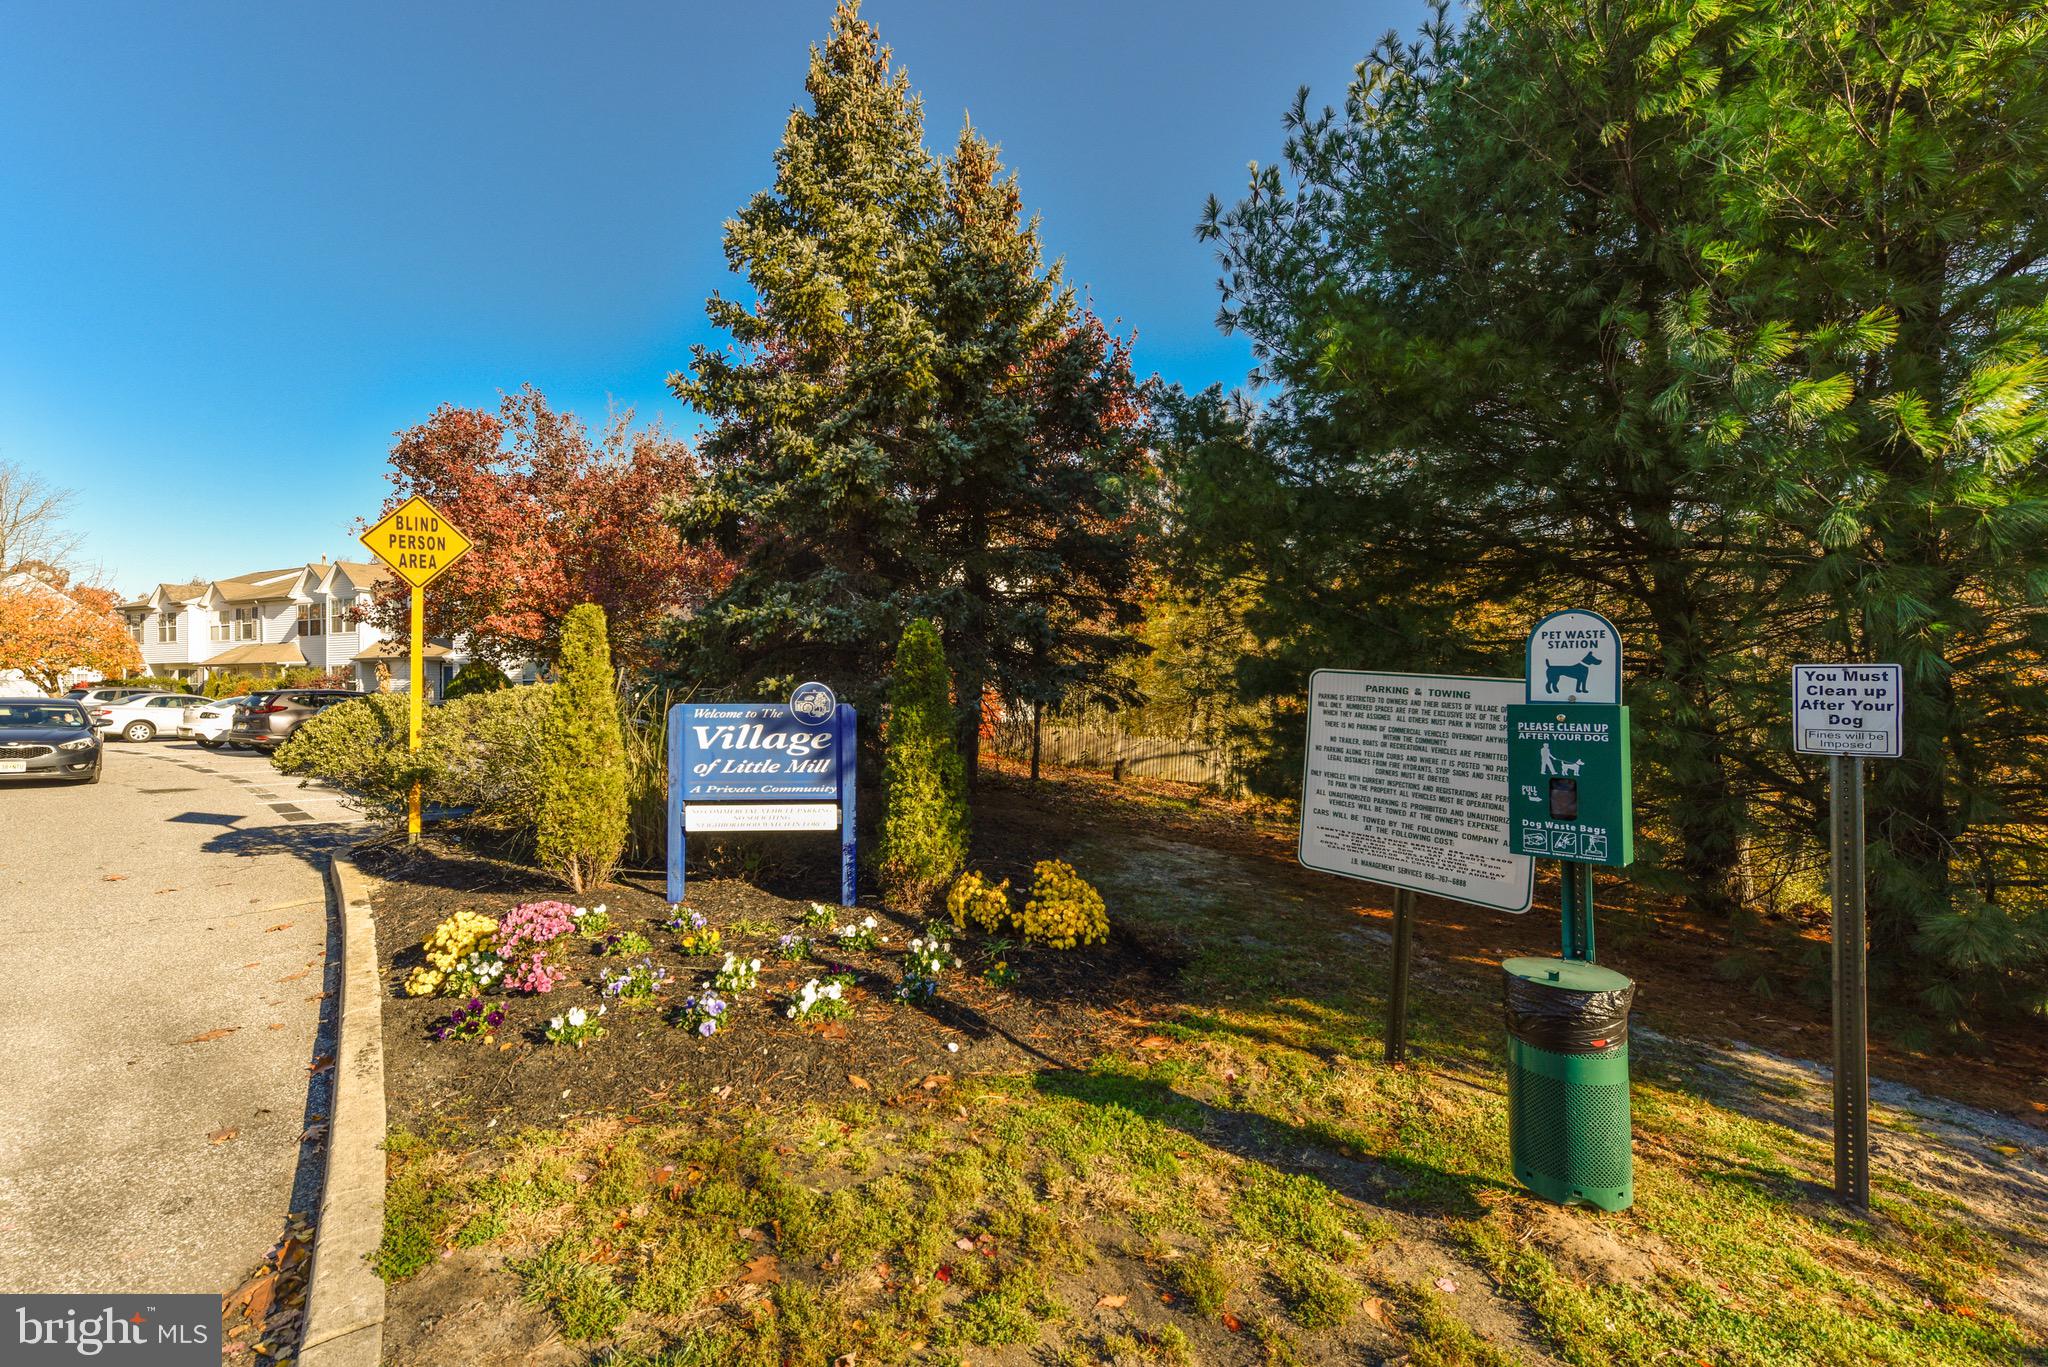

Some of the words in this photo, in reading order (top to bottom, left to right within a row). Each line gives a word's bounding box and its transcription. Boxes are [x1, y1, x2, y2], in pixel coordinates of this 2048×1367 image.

[396, 516, 439, 532] BLIND
[389, 534, 446, 551] PERSON
[399, 553, 437, 569] AREA
[1542, 631, 1562, 639] PET
[1566, 630, 1605, 639] WASTE
[1548, 640, 1598, 649] STATION
[1805, 671, 1836, 682] You
[1844, 671, 1888, 682] Must
[1365, 684, 1409, 694] PARKING
[1427, 688, 1470, 698] TOWING
[1807, 686, 1857, 696] Clean
[1864, 688, 1886, 699] up
[1346, 694, 1375, 703] RESTRICTED
[1386, 697, 1407, 705] OWNERS
[1474, 703, 1498, 712] VILLAGE
[1800, 700, 1845, 710] After
[1851, 700, 1894, 711] Your
[694, 708, 743, 718] Welcome
[746, 710, 757, 718] to
[762, 708, 783, 718] The
[1433, 709, 1462, 718] EXCLUSIVE
[1473, 722, 1496, 730] VISITOR
[1518, 722, 1554, 731] PLEASE
[1557, 723, 1590, 732] CLEAN
[1594, 724, 1608, 732] UP
[1829, 715, 1863, 728] Dog
[693, 724, 832, 755] Village
[1388, 726, 1420, 735] COMMERCIAL
[1423, 729, 1449, 738] VEHICLES
[1451, 732, 1482, 741] OVERNIGHT
[1485, 735, 1507, 744] ANYWH
[1808, 731, 1841, 739] Fines
[1389, 742, 1428, 752] RECREATIONAL
[1430, 746, 1457, 755] VEHICLES
[1820, 740, 1872, 749] Imposed
[1323, 745, 1343, 753] PARKING
[1363, 750, 1384, 758] YELLOW
[1386, 752, 1403, 760] CURBS
[1419, 756, 1438, 765] WHERE
[1456, 760, 1480, 770] POSTED
[693, 759, 719, 776] of
[720, 759, 781, 774] Little
[784, 759, 831, 773] Mill
[1344, 756, 1370, 765] DISTANCES
[1452, 769, 1469, 777] SIGNS
[1374, 768, 1398, 777] CORNERS
[1400, 771, 1415, 779] MUST
[706, 785, 756, 793] Private
[760, 785, 837, 794] Community
[1323, 771, 1345, 779] VEHICLES
[1362, 776, 1384, 785] CURRENT
[1386, 779, 1420, 790] INSPECTIONS
[1435, 786, 1478, 798] REGISTRATIONS
[1411, 791, 1436, 801] VEHICLES
[1438, 795, 1453, 803] MUST
[1328, 790, 1371, 802] UNAUTHORIZED
[1373, 797, 1398, 807] PARKING
[1410, 802, 1447, 814] PROHIBITED
[1450, 808, 1463, 817] AND
[1466, 811, 1509, 824] UNAUTHORIZ
[1328, 798, 1354, 808] VEHICLES
[1357, 802, 1371, 811] WILL
[1385, 807, 1406, 816] TOWED
[1420, 812, 1431, 820] THE
[1434, 814, 1464, 826] OWNER'S
[1312, 807, 1329, 816] CARS
[1332, 811, 1347, 819] WILL
[1362, 816, 1385, 826] TOWED
[1400, 822, 1414, 830] THE
[1417, 825, 1458, 838] FOLLOWING
[1461, 832, 1498, 845] COMPANY
[1522, 819, 1542, 829] Dog
[1545, 821, 1576, 831] Waste
[1580, 825, 1606, 834] Bags
[1375, 826, 1388, 834] THE
[1391, 829, 1430, 842] FOLLOWING
[1360, 859, 1394, 872] MANAGEMENT
[1397, 866, 1422, 878] SERVICES
